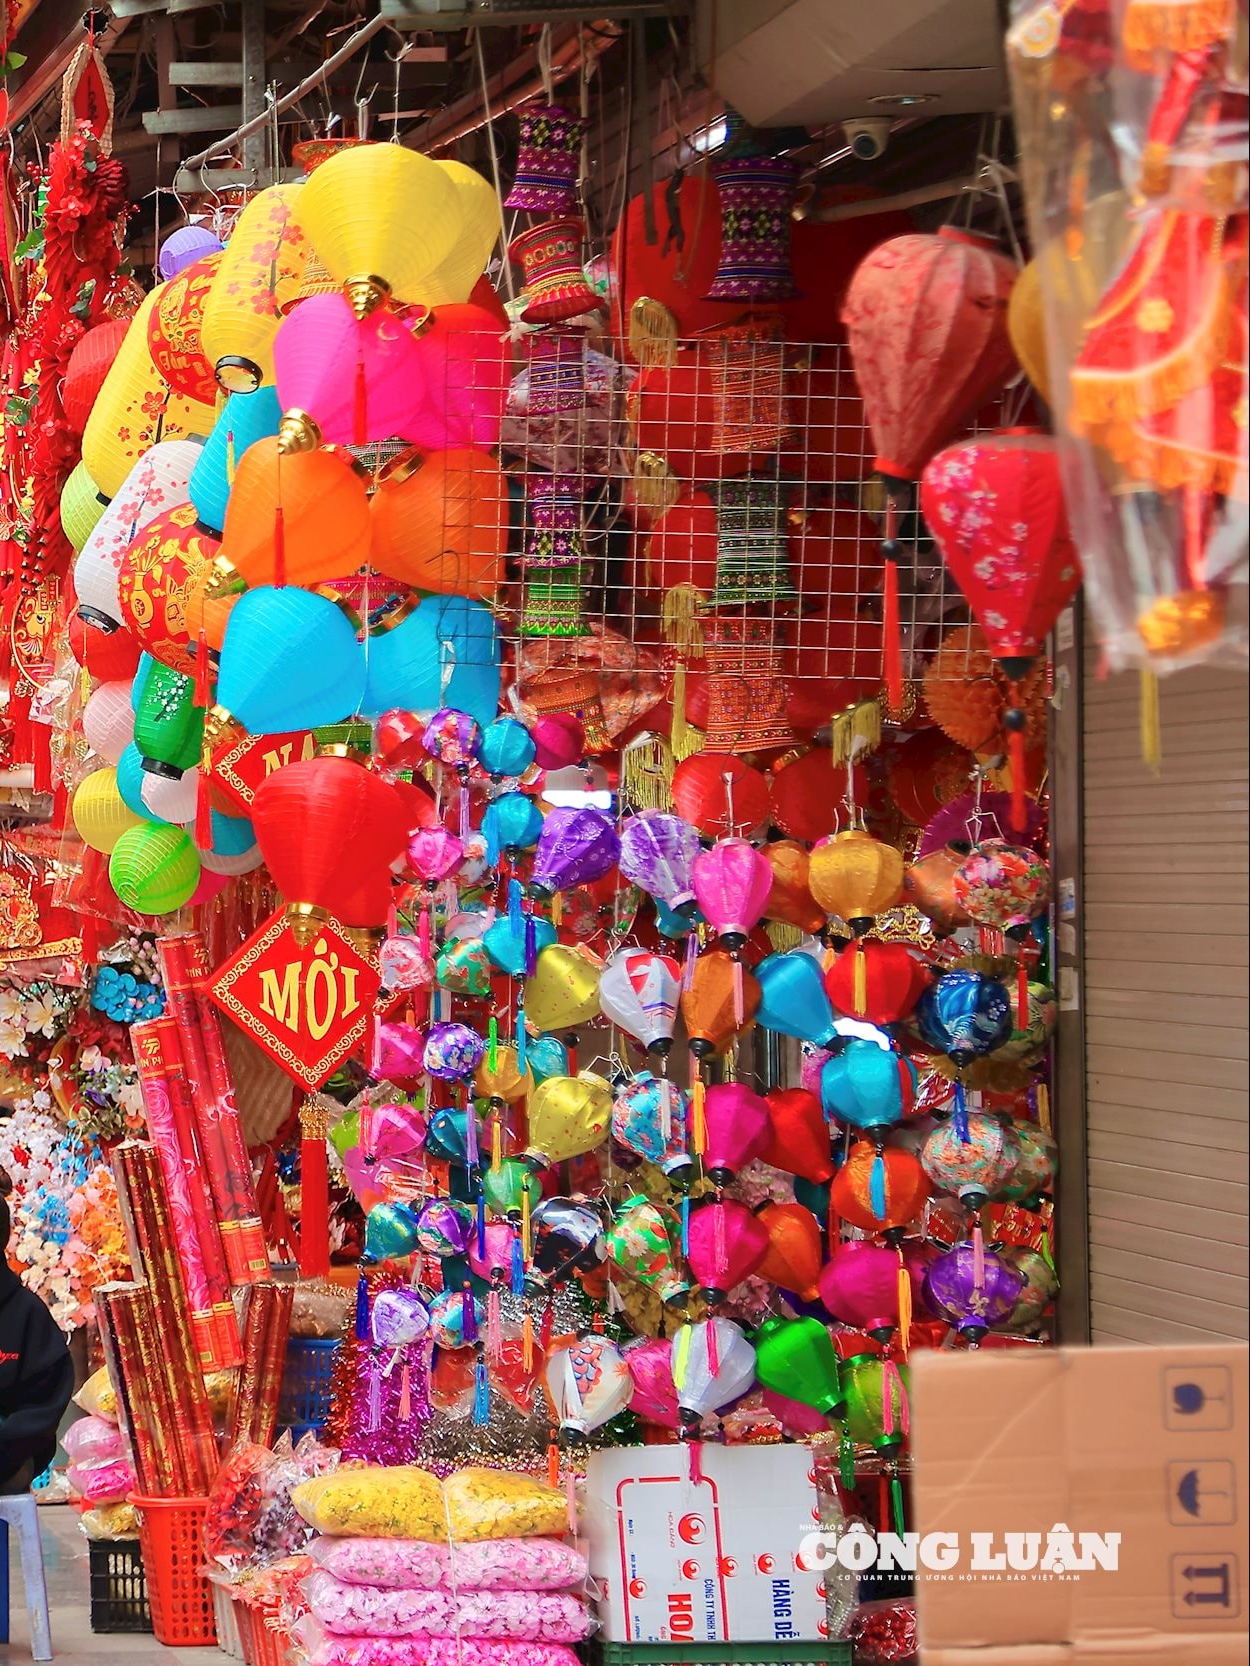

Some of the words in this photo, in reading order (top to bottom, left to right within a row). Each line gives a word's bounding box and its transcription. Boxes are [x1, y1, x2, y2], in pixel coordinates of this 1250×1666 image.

[258, 937, 360, 1041] MỚI
[704, 1578, 715, 1599] CÔNG
[772, 1579, 793, 1617] HÀNG
[706, 1600, 715, 1609] TY
[706, 1611, 716, 1630] TNHH
